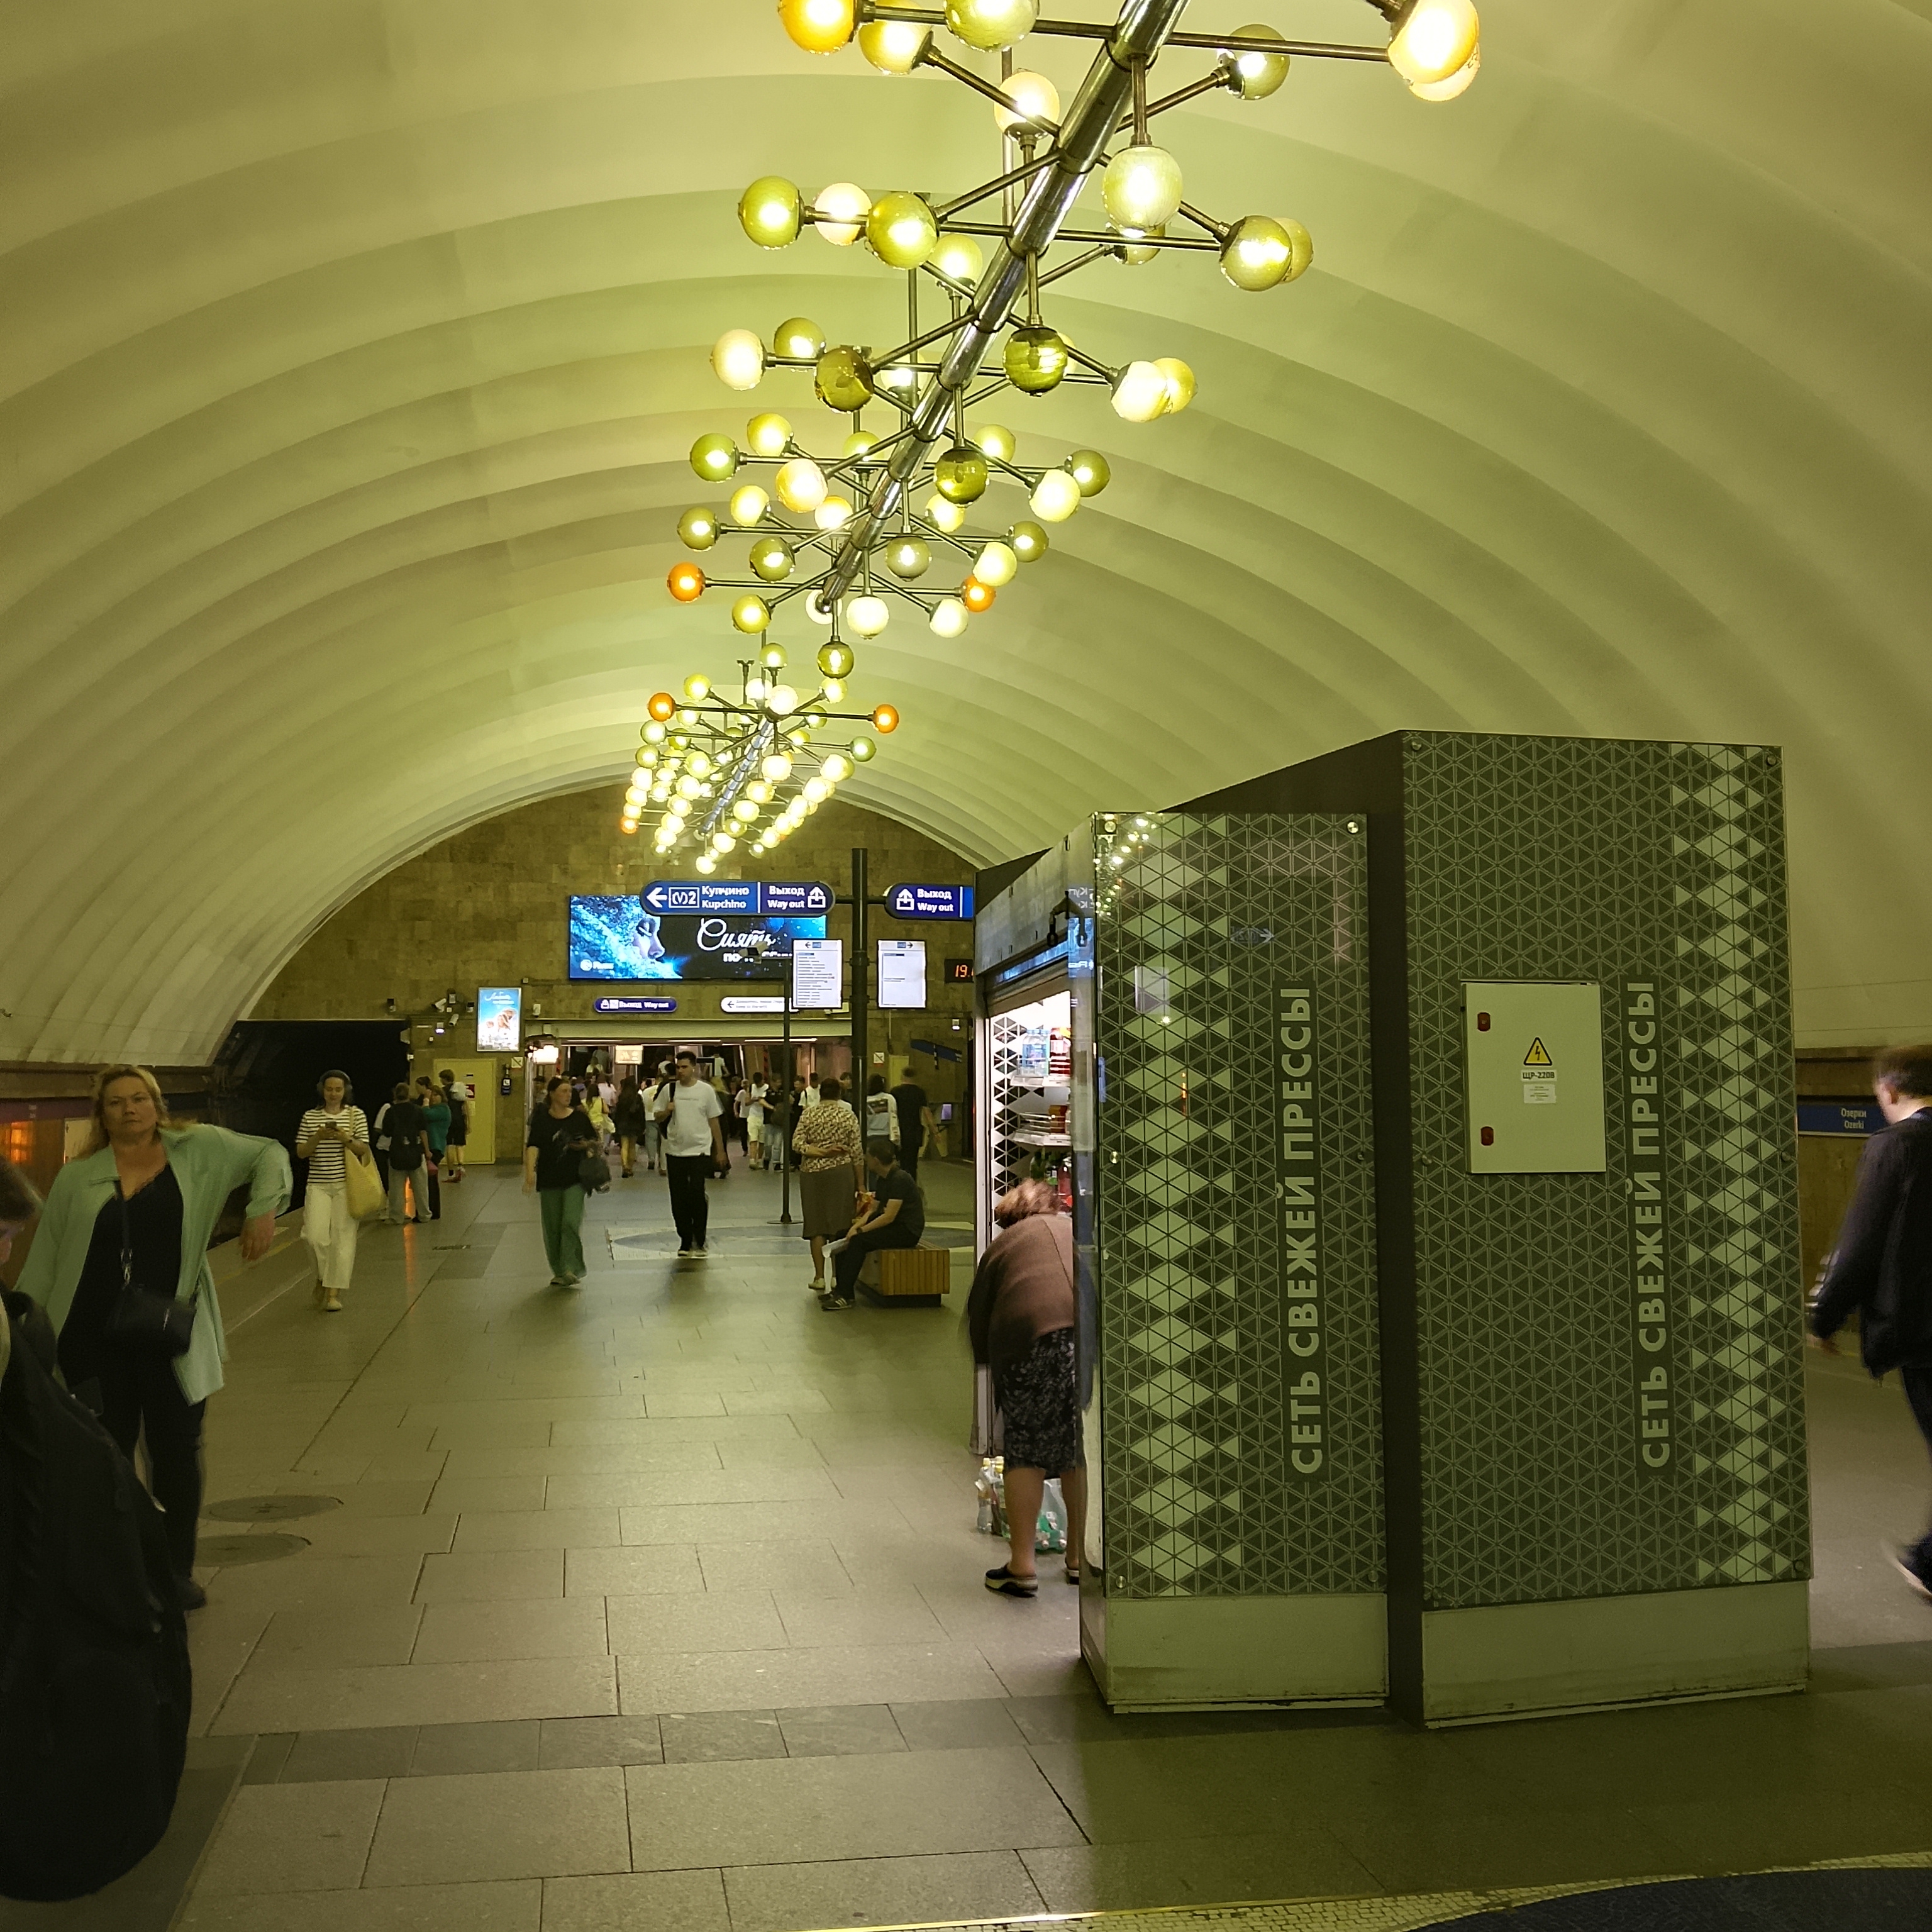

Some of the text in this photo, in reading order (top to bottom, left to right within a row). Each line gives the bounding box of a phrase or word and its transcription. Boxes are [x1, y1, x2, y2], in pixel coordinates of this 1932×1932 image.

[702, 886, 750, 897] Купчино
[769, 886, 805, 897] Выход
[917, 888, 952, 900] Выход
[701, 899, 747, 910] Kupchino
[767, 899, 787, 910] Way
[917, 902, 953, 913] Way out
[1523, 1071, 1555, 1080] ЩР-220В
[1841, 1108, 1867, 1119] Озерки
[1844, 1121, 1864, 1130] Ozerki
[1625, 982, 1670, 1468] СЕТЬ СВЕЖЕЙ ПРЕССЫ
[1276, 989, 1323, 1474] СЕТЬ СВЕЖЕЙ ПРЕССЫ
